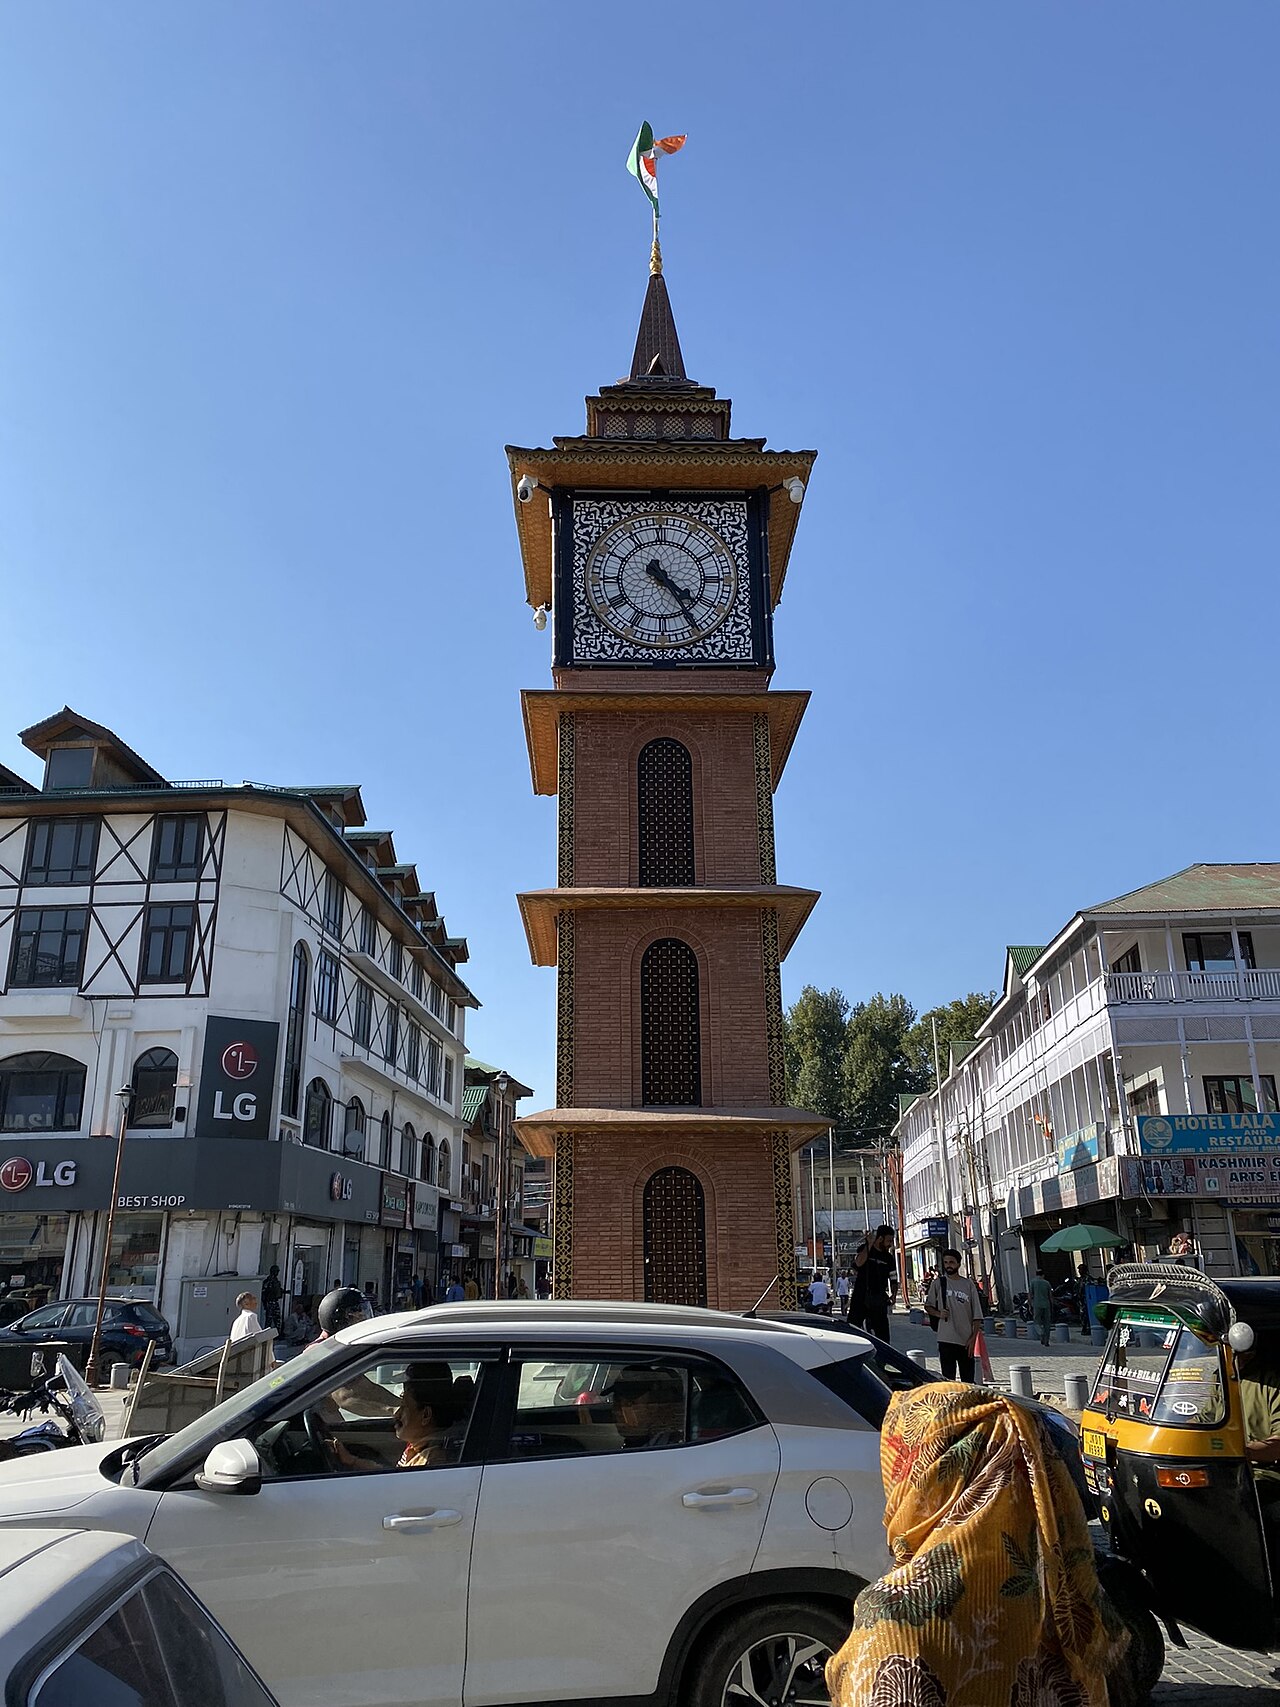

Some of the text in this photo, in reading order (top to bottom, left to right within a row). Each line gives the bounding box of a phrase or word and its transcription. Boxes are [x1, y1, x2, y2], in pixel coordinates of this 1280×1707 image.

[213, 1090, 257, 1120] LG
[1174, 1114, 1275, 1130] HOTEL LALA
[1199, 1157, 1267, 1169] KASHMIR
[36, 1160, 76, 1187] LG
[1229, 1171, 1265, 1182] ARTS
[342, 1178, 353, 1199] LG
[117, 1195, 186, 1207] BEST SHOP
